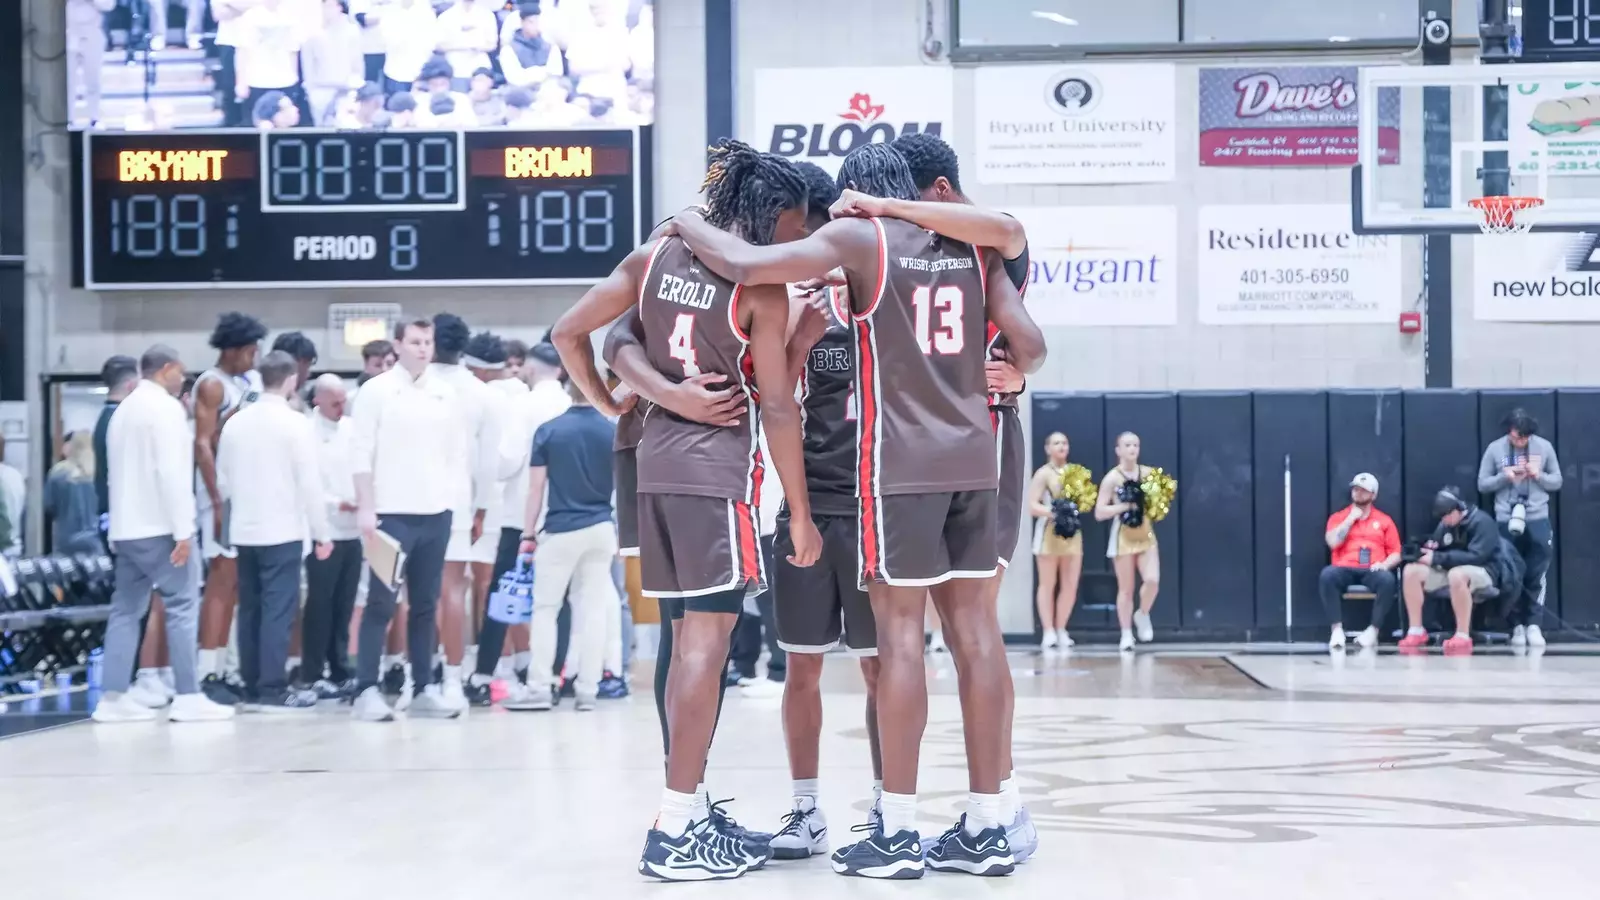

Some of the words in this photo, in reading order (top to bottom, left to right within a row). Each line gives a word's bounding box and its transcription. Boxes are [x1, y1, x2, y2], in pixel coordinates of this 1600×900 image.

[1234, 71, 1356, 118] Dave's
[988, 119, 1054, 137] Bryant
[1062, 117, 1166, 136] University
[504, 146, 592, 178] BROWN
[1297, 146, 1322, 156] and
[118, 150, 228, 182] BRYANT
[293, 235, 377, 261] PERIOD
[1208, 228, 1350, 250] Residence
[899, 256, 973, 273] WRISBY-JEFFERSON
[1029, 254, 1164, 293] avigant
[1239, 268, 1350, 284] 401-305-6950
[657, 273, 716, 310] EROLD
[1493, 281, 1546, 297] new
[911, 285, 965, 355] 13
[668, 311, 702, 377] 4
[811, 348, 852, 372] BR
